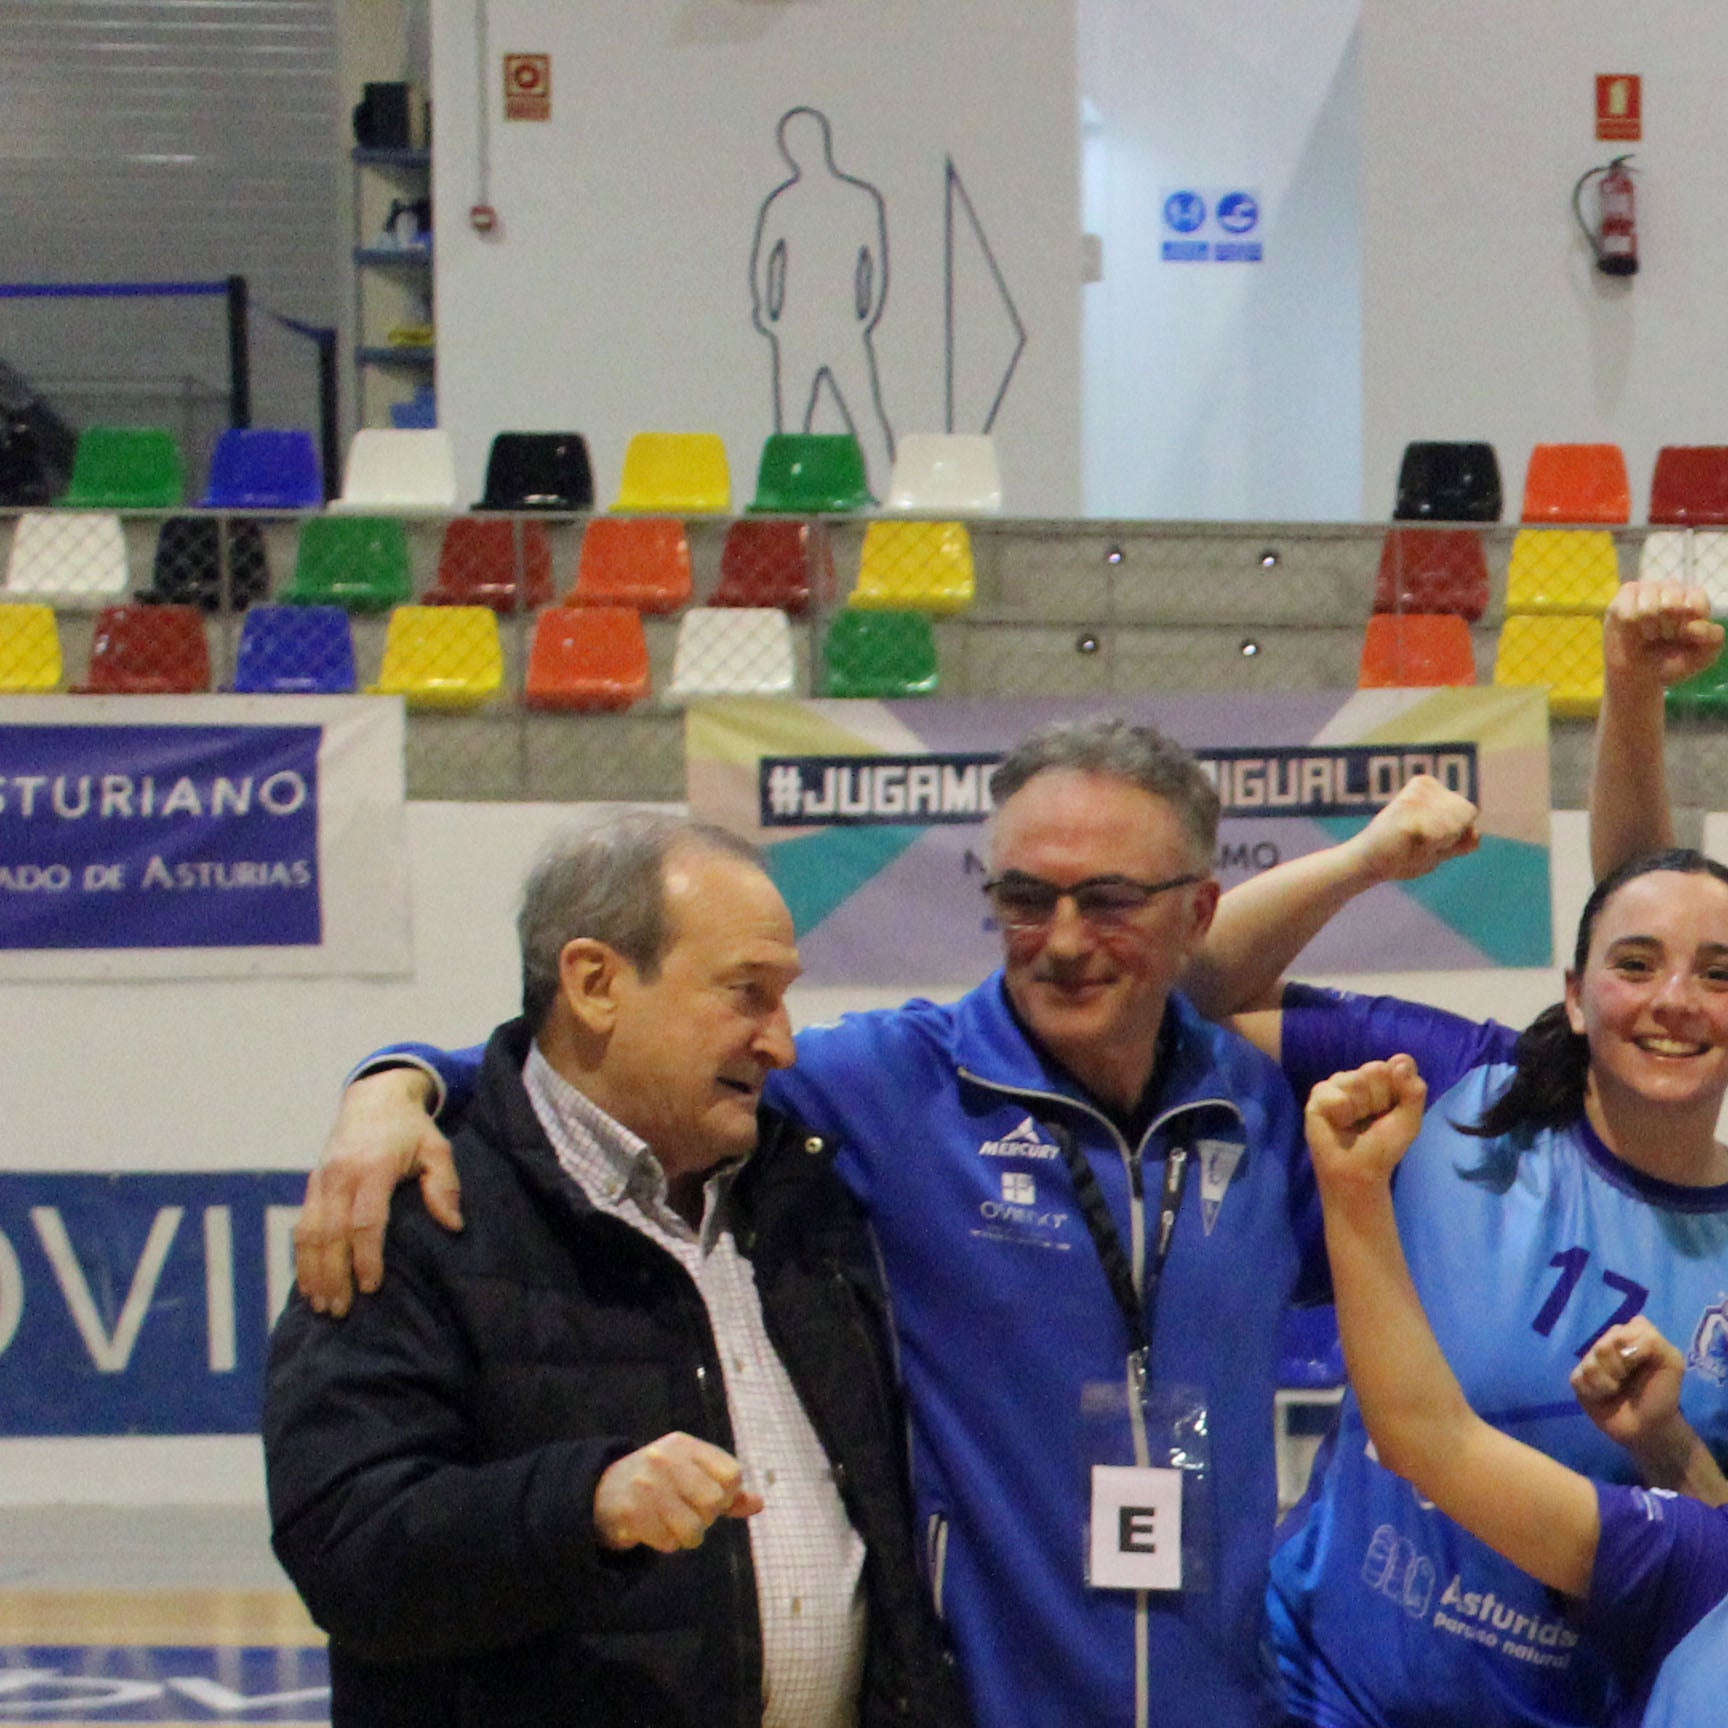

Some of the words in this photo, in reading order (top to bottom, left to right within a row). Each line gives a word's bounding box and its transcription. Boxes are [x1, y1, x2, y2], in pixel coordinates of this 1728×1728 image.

[84, 865, 125, 891] DE
[978, 1141, 1061, 1160] MERCURY
[1531, 1244, 1649, 1357] 17
[1118, 1506, 1156, 1553] E
[1440, 1573, 1579, 1648] Asturias
